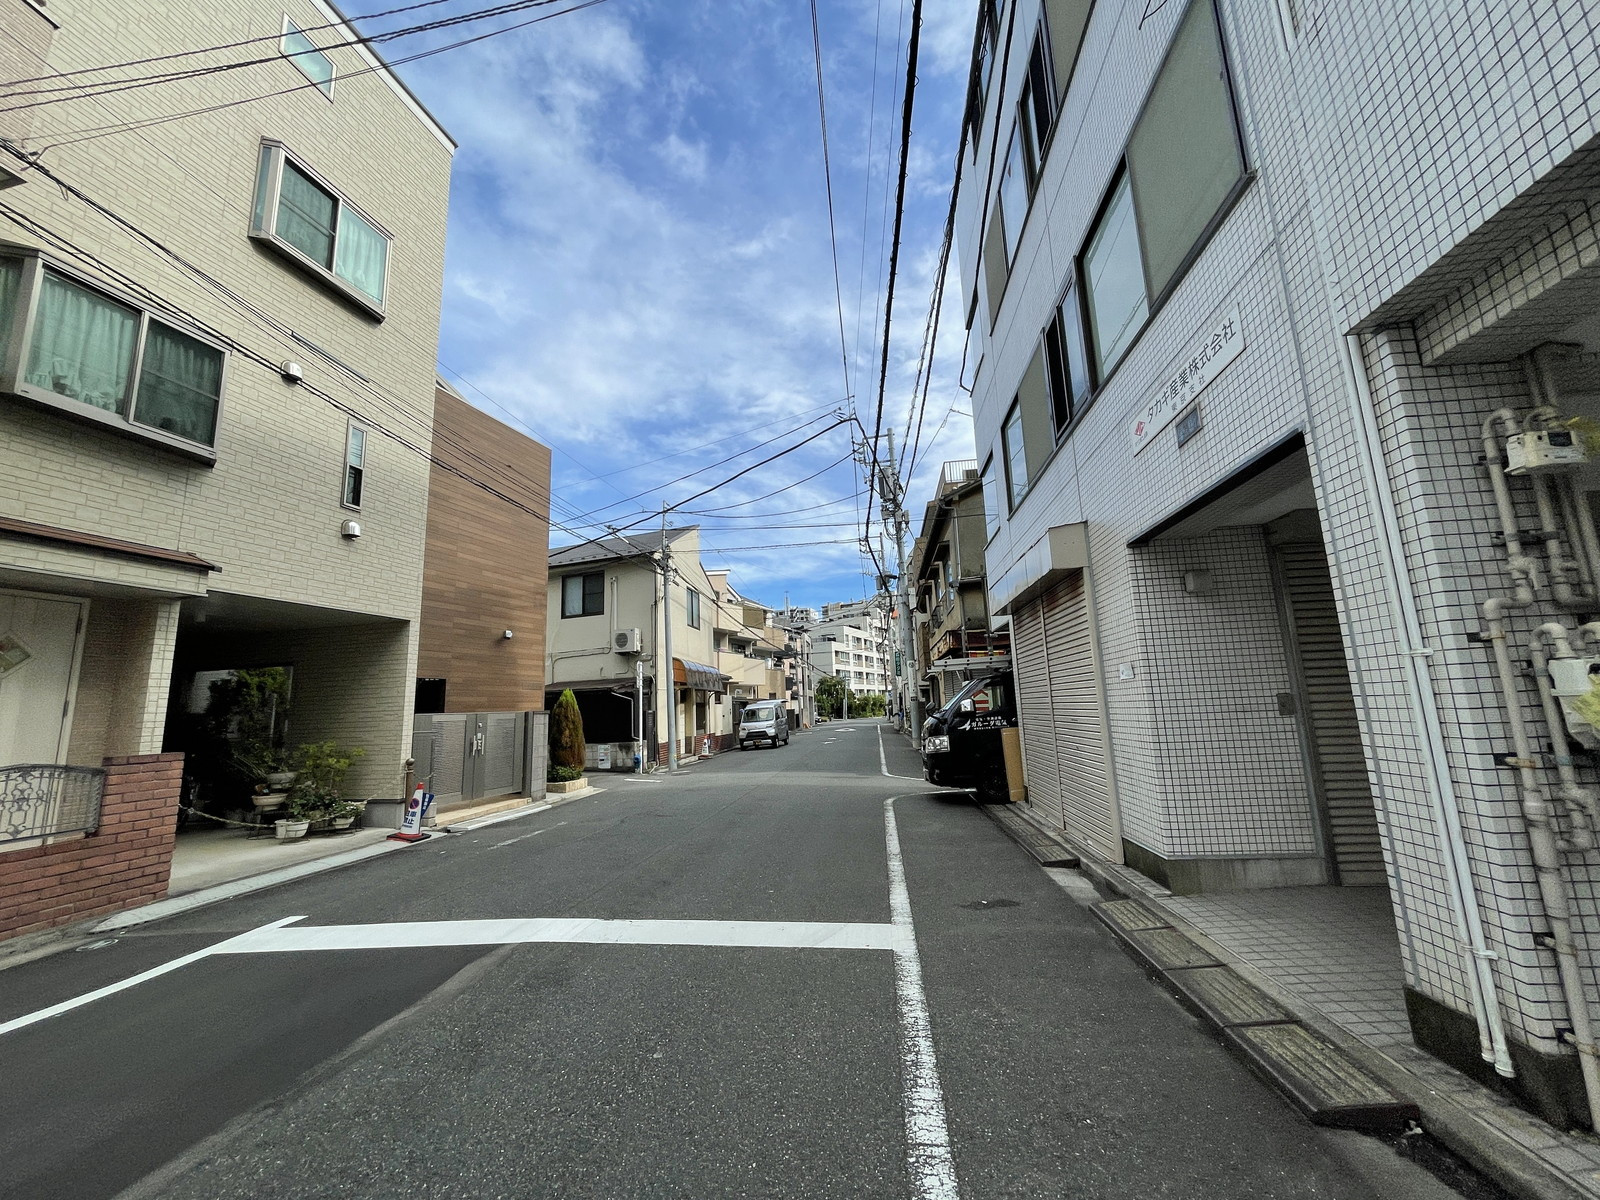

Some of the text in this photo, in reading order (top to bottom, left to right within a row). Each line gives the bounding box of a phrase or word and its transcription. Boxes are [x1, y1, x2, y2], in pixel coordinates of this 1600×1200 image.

[1147, 317, 1237, 424] タカギ産業株式会社
